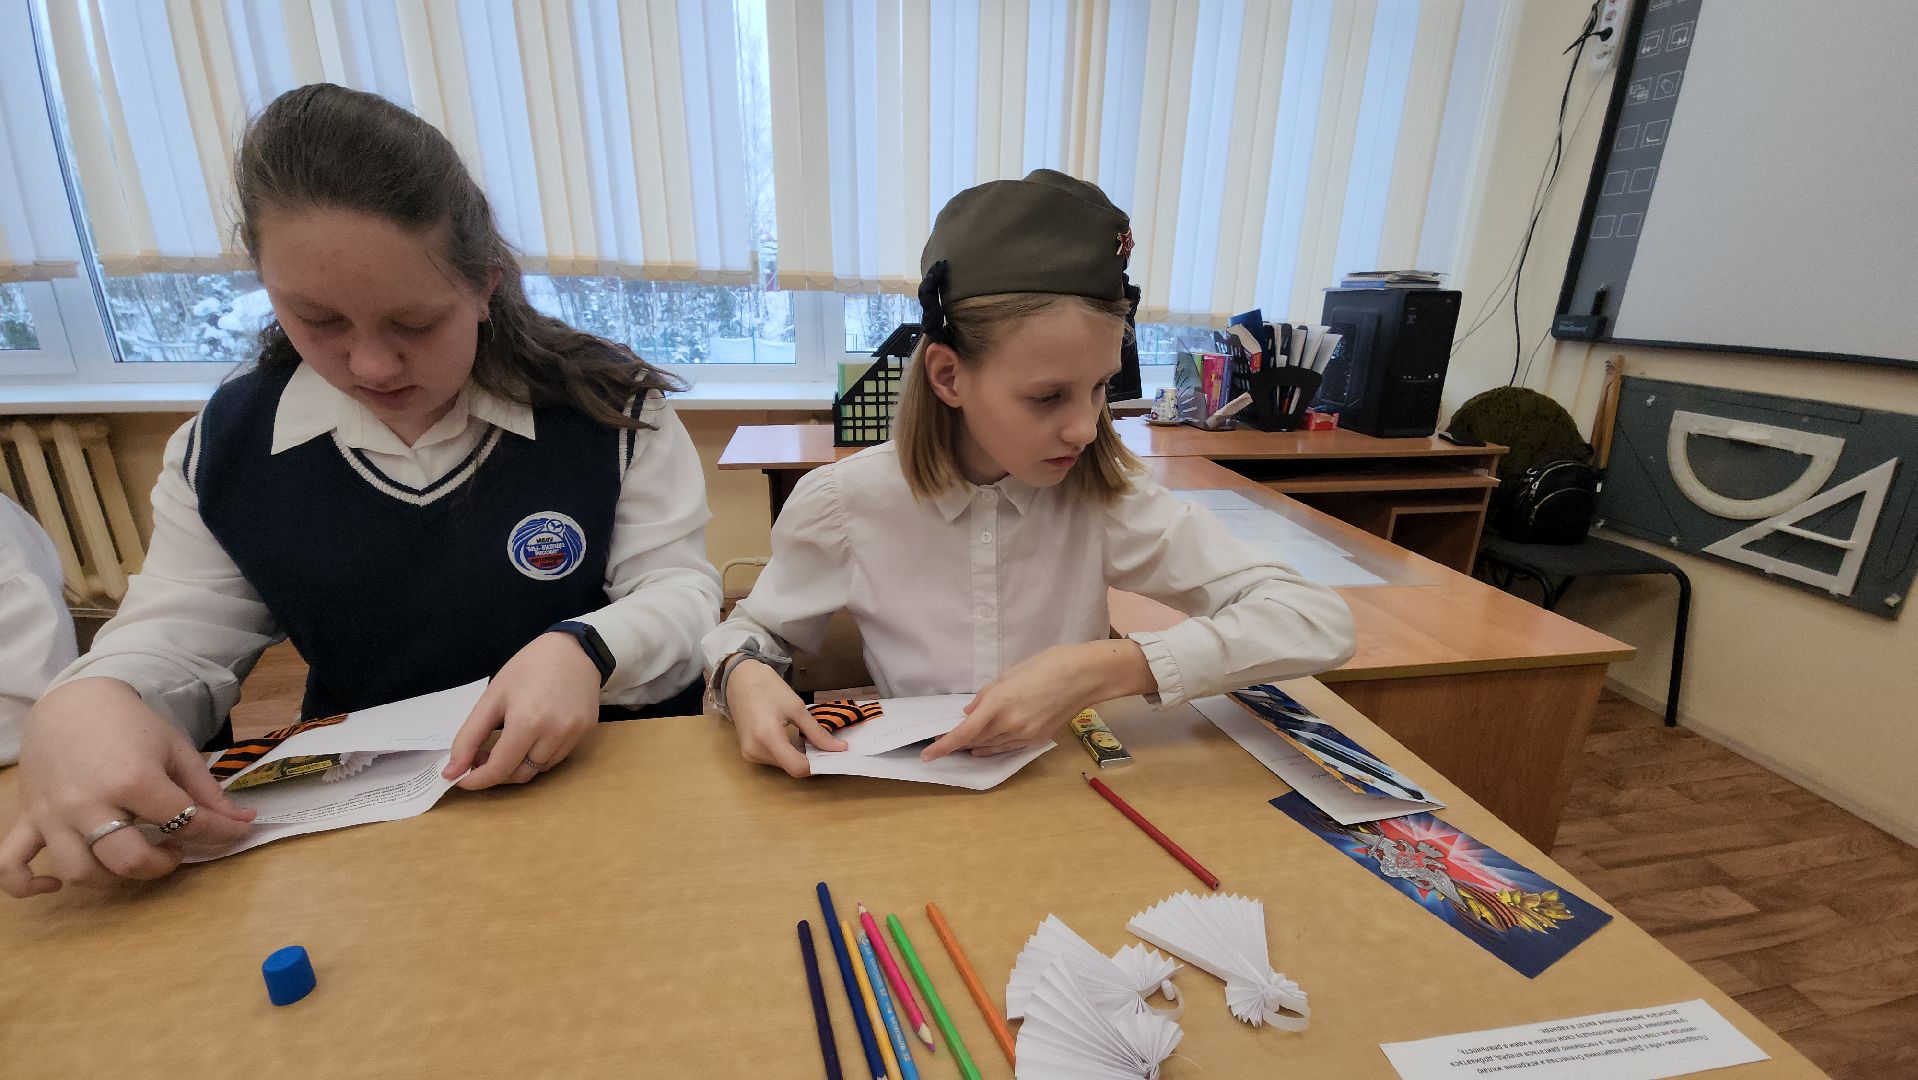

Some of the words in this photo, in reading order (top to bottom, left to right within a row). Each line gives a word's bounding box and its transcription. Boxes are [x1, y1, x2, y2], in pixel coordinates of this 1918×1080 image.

[1665, 1035, 1708, 1045] Поздравляю
[1456, 1044, 1503, 1054] реальность,
[1524, 1046, 1560, 1057] двигаться
[1584, 1048, 1622, 1058] защитника
[1450, 1056, 1494, 1067] добиваться
[1546, 1055, 1584, 1064] Отечества
[1477, 1066, 1503, 1074] желаю
[1504, 1061, 1539, 1070] искренне
